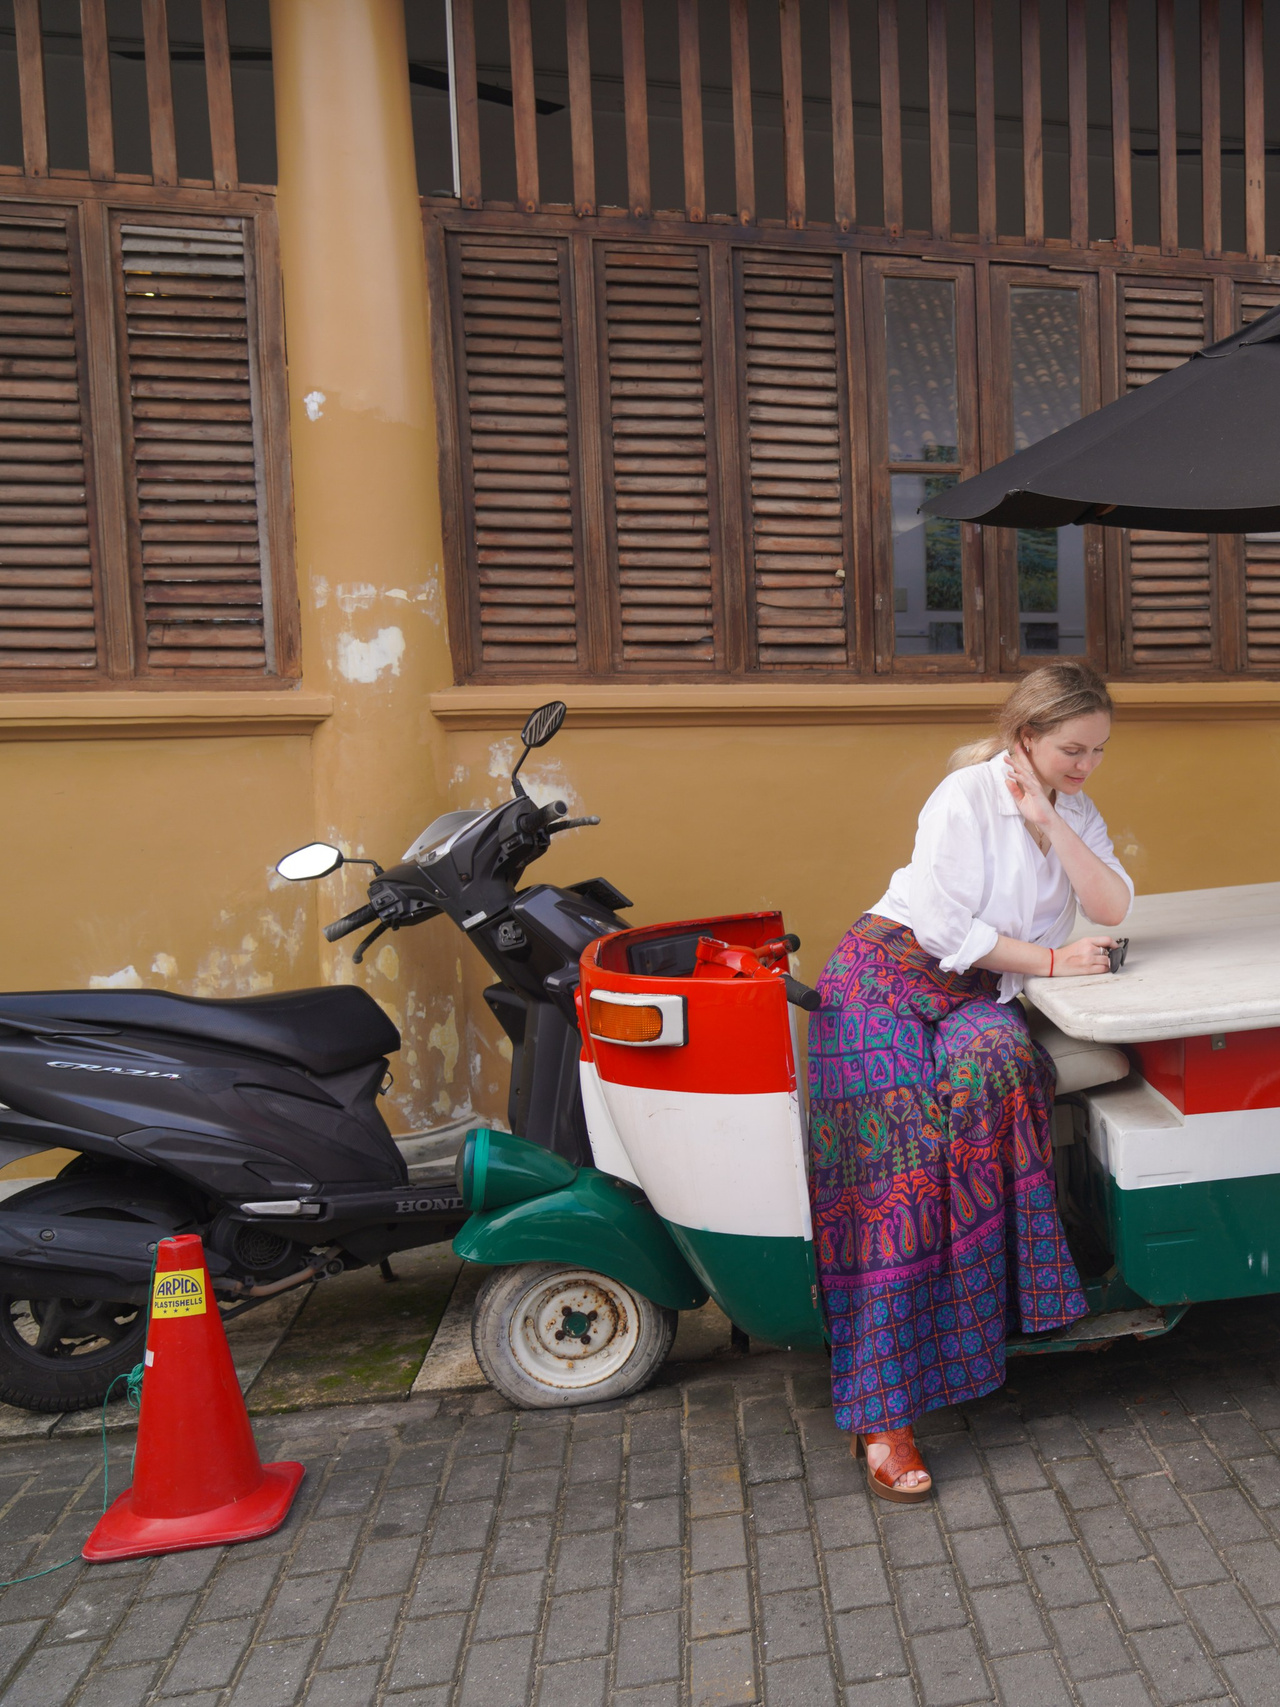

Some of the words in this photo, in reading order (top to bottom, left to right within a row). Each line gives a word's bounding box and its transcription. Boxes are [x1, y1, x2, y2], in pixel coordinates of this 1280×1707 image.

[46, 1060, 182, 1081] GRAZIA
[395, 1197, 464, 1213] HOND
[156, 1277, 199, 1296] ARPICO
[154, 1297, 203, 1309] PLASTISHELLS
